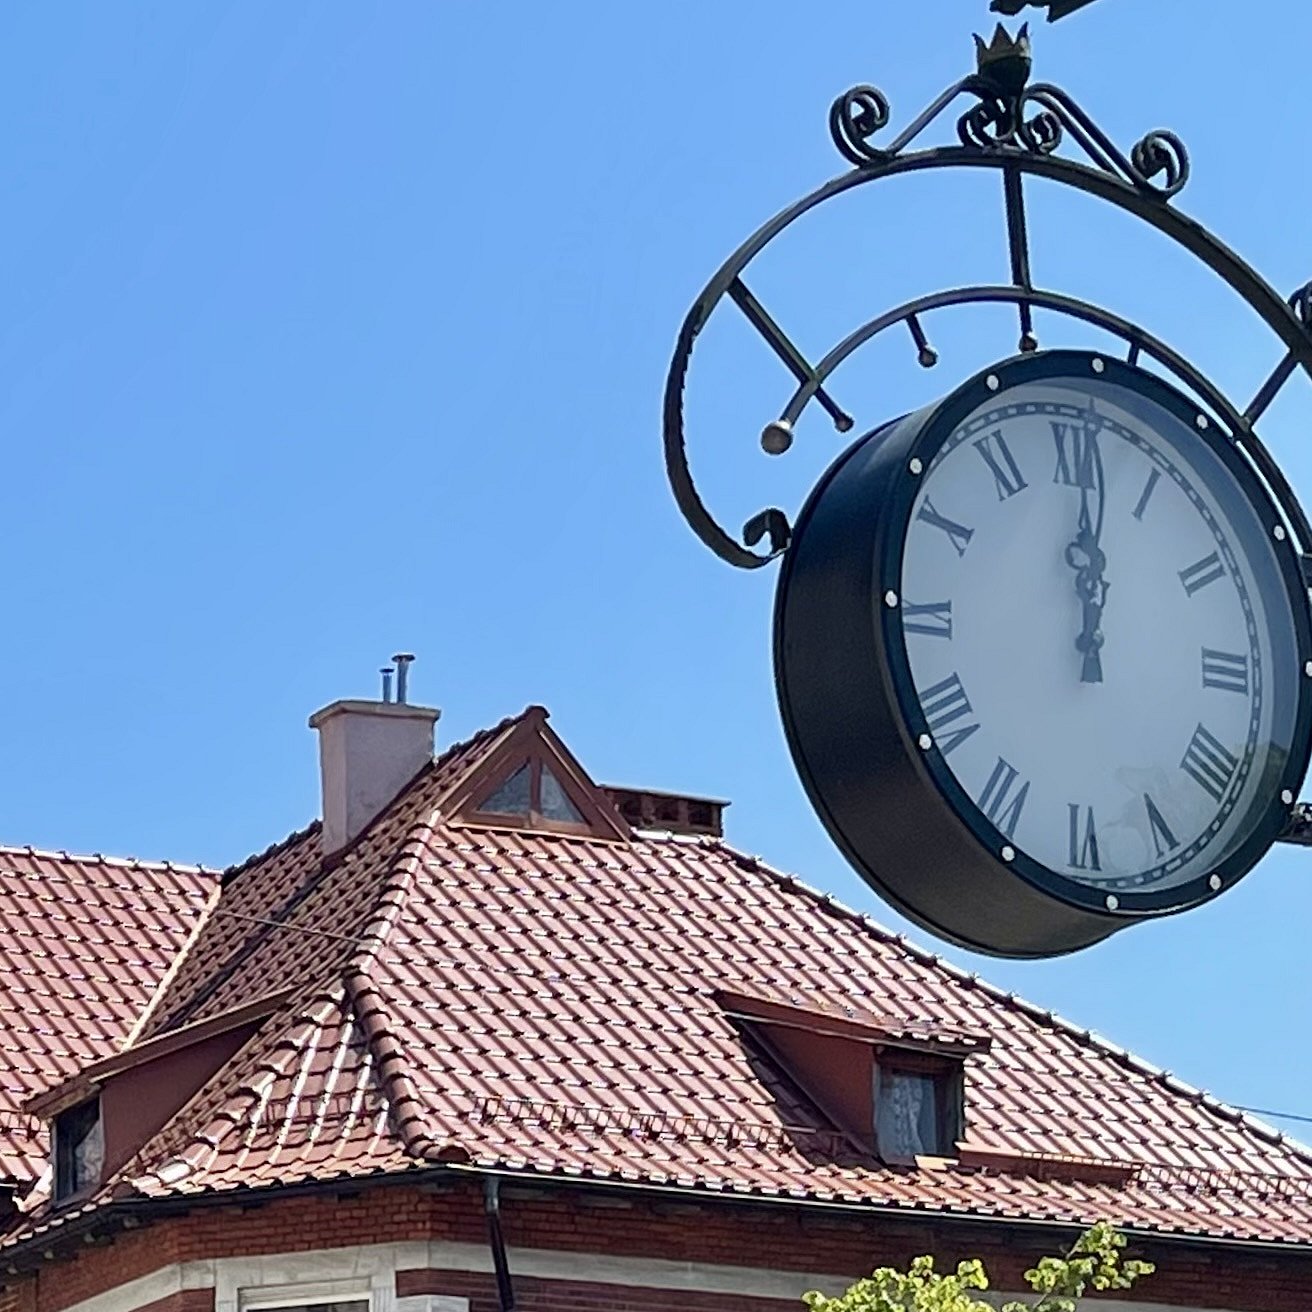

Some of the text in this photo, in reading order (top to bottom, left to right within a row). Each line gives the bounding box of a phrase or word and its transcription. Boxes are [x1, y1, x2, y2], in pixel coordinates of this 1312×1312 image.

[973, 430, 1029, 501] XI
[1132, 468, 1162, 521] I
[915, 495, 975, 557] X
[1177, 551, 1227, 598] II
[902, 600, 953, 640] IX
[1201, 646, 1249, 696] III
[978, 756, 1031, 841] VII
[1143, 792, 1181, 859] V
[1067, 803, 1102, 871] VI
